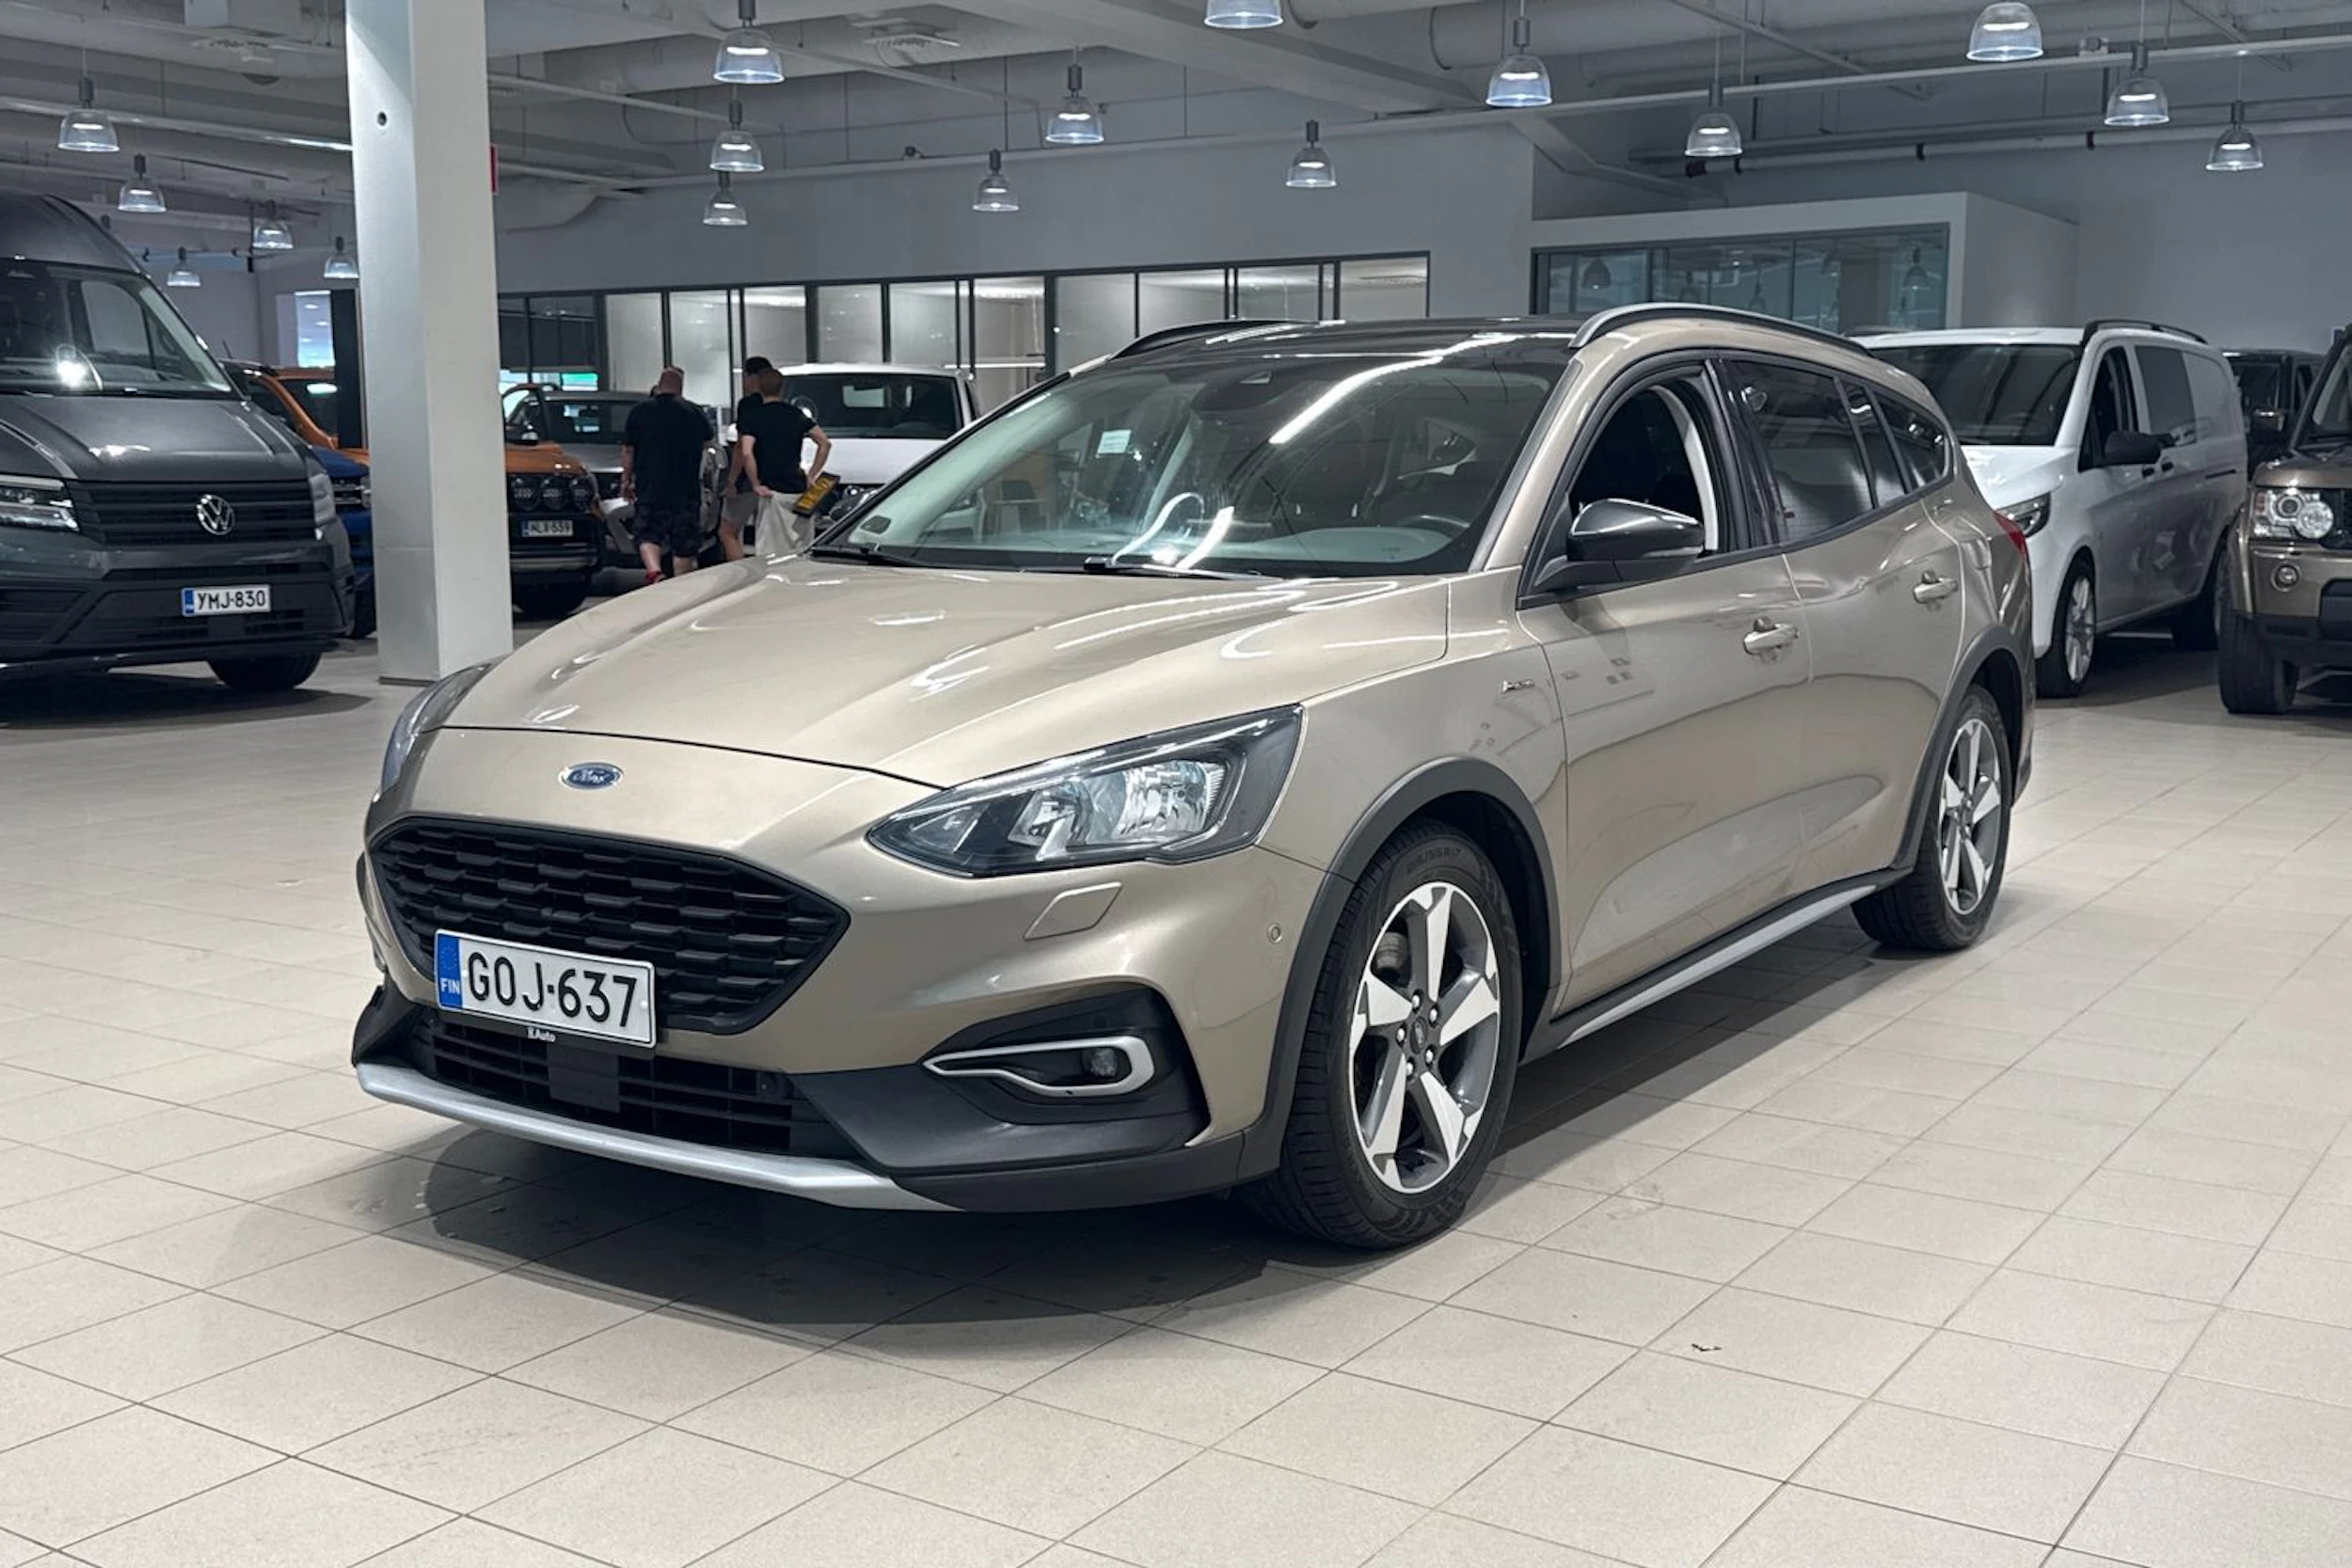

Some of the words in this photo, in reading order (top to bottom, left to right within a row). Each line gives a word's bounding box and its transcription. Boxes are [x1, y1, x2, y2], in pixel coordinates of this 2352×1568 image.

[198, 590, 265, 610] YMJ-830
[440, 977, 460, 995] FIN
[468, 951, 638, 1028] GOJ-637
